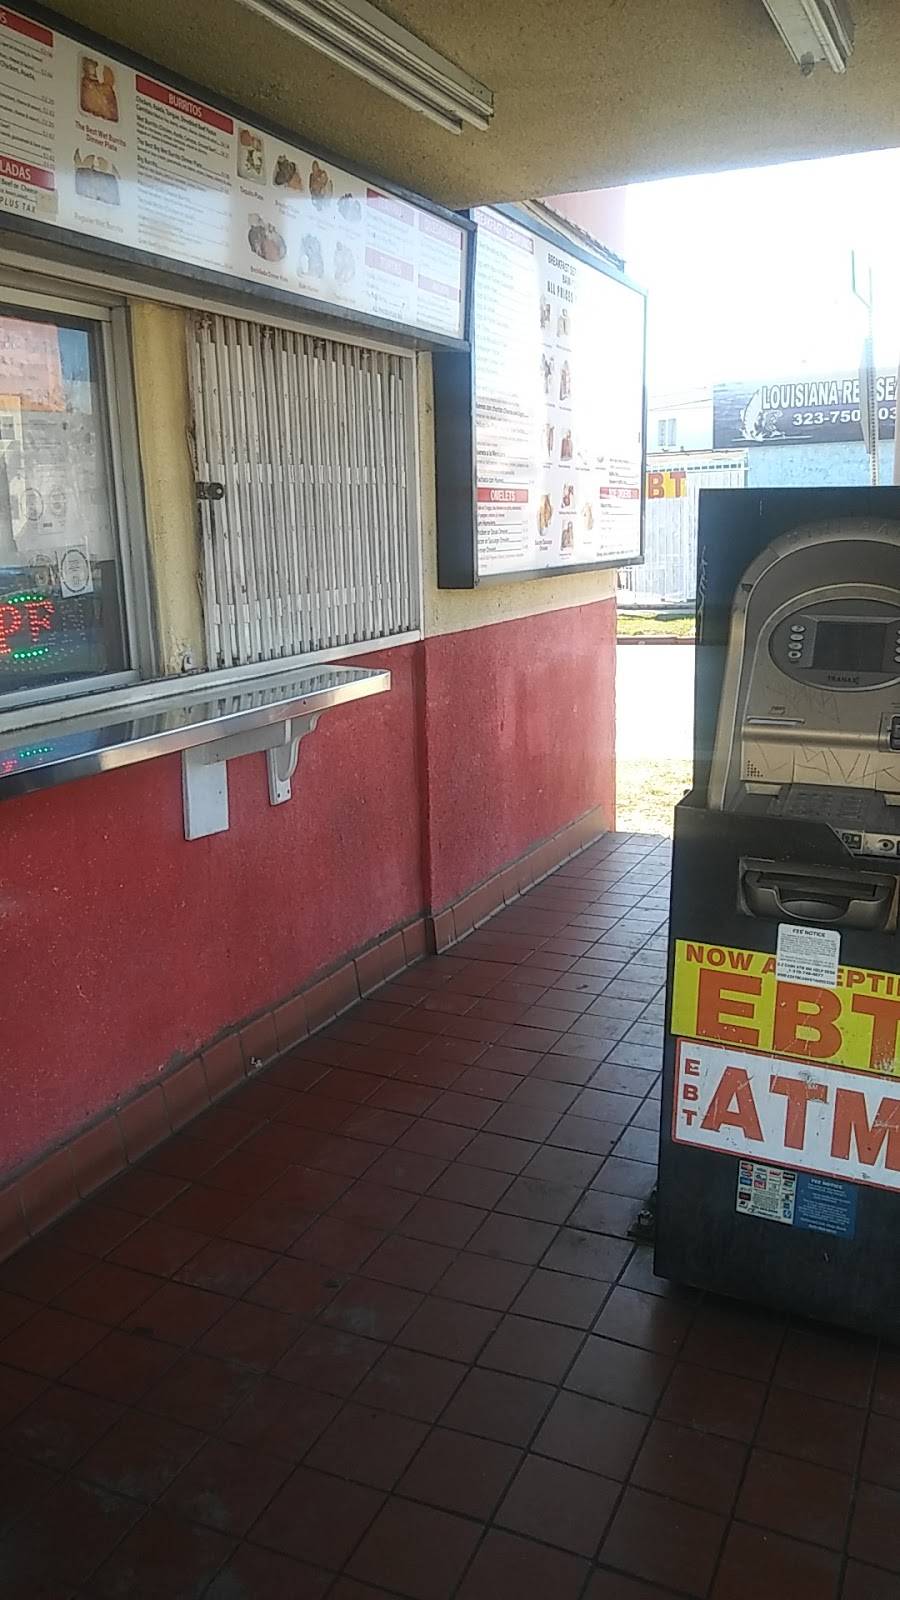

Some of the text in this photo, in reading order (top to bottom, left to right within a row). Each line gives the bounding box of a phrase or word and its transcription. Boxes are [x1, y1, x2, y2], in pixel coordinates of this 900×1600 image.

[168, 93, 203, 118] BURRITOS
[0, 196, 36, 213] PLUS TAX
[761, 380, 838, 409] LOUISIANA
[804, 930, 826, 938] NOTICE
[686, 943, 754, 972] NOW
[695, 967, 900, 1070] EBT
[682, 1058, 702, 1127] EBT
[700, 1065, 900, 1172] ATM
